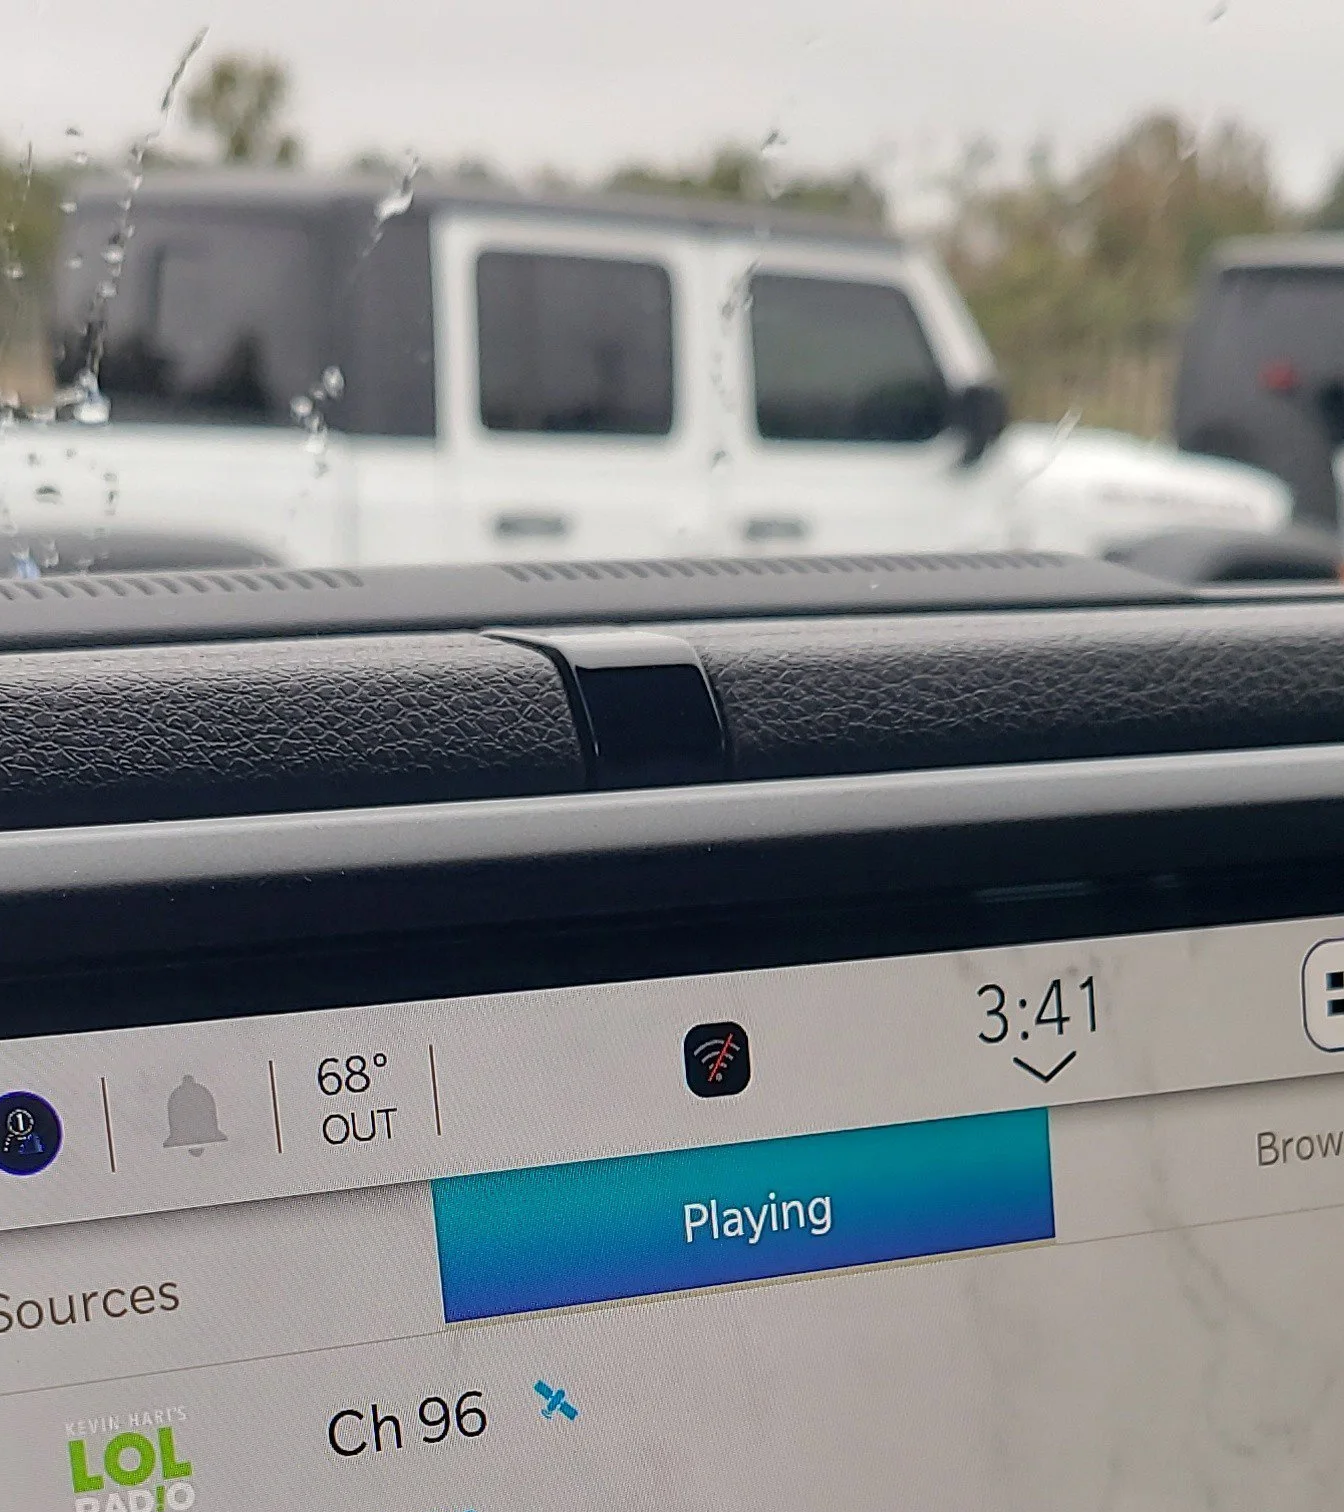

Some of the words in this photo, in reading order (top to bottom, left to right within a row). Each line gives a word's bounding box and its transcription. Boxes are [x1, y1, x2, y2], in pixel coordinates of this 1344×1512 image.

[977, 975, 1100, 1043] 3:41
[322, 1108, 398, 1146] OUT
[684, 1192, 833, 1243] Playing
[66, 1416, 119, 1436] KEVIN
[328, 1405, 402, 1457] Ch
[418, 1391, 488, 1442] 96
[68, 1426, 193, 1493] LOL
